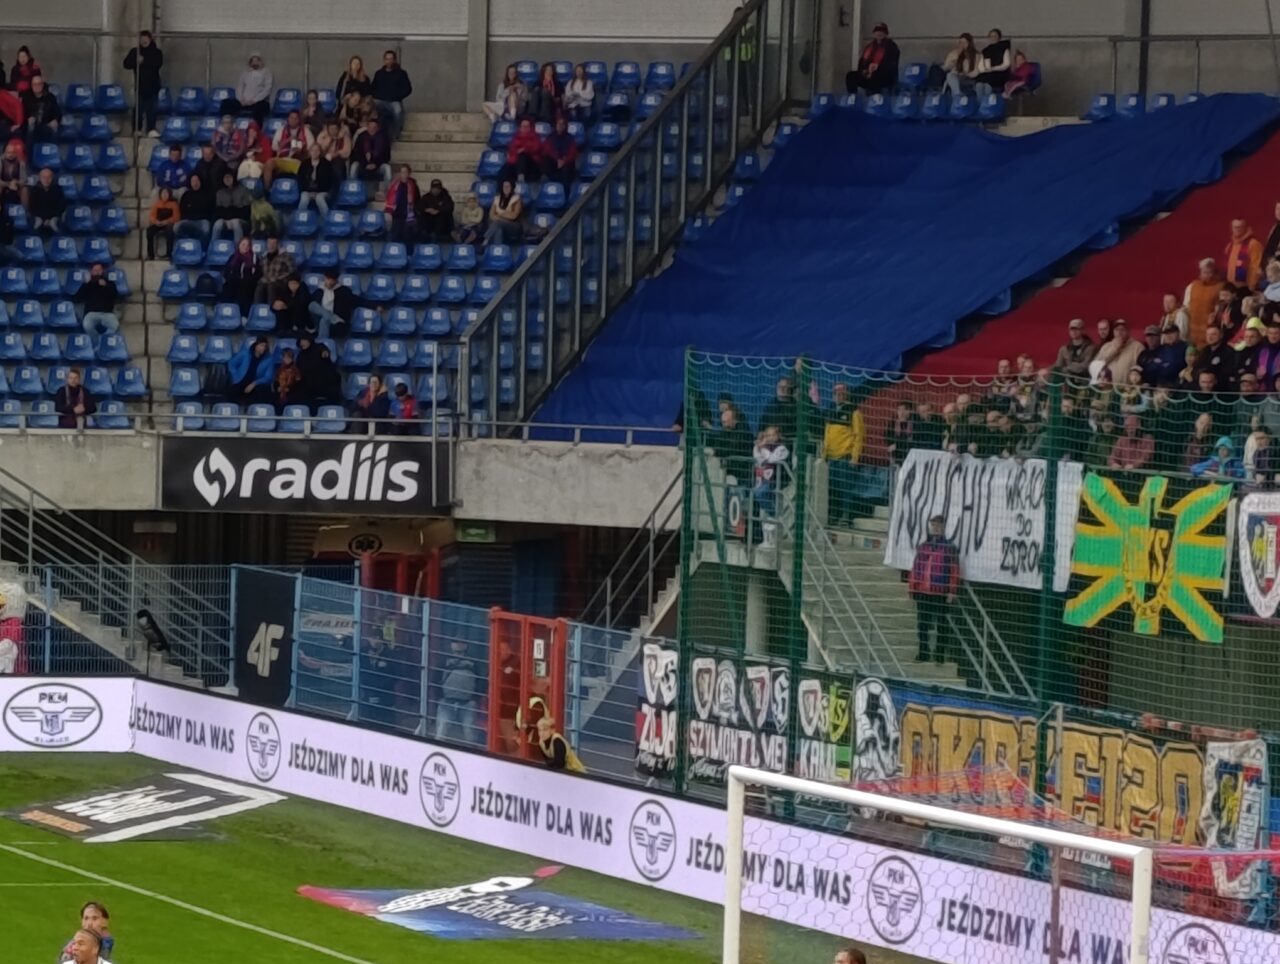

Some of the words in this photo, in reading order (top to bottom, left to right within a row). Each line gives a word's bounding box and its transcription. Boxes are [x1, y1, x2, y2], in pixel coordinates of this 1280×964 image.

[1006, 465, 1047, 510] WRAC
[1000, 536, 1042, 576] ZDRO
[246, 622, 285, 677] 4F
[39, 692, 68, 703] PKM
[129, 702, 181, 741] JEŹDZIMY
[185, 718, 206, 748] DLA
[210, 723, 234, 754] WAS
[288, 739, 348, 780] JEŹDZIMY
[351, 761, 375, 788] DLA
[380, 765, 408, 796] WAS
[471, 782, 540, 828] JEŹDZIMY
[546, 804, 573, 836] DLA
[580, 810, 613, 846] WAS
[686, 833, 768, 885] JEŹDMY
[773, 858, 806, 895] DLA
[813, 867, 852, 905] WAS
[937, 894, 1036, 949] JEŹDZIMY
